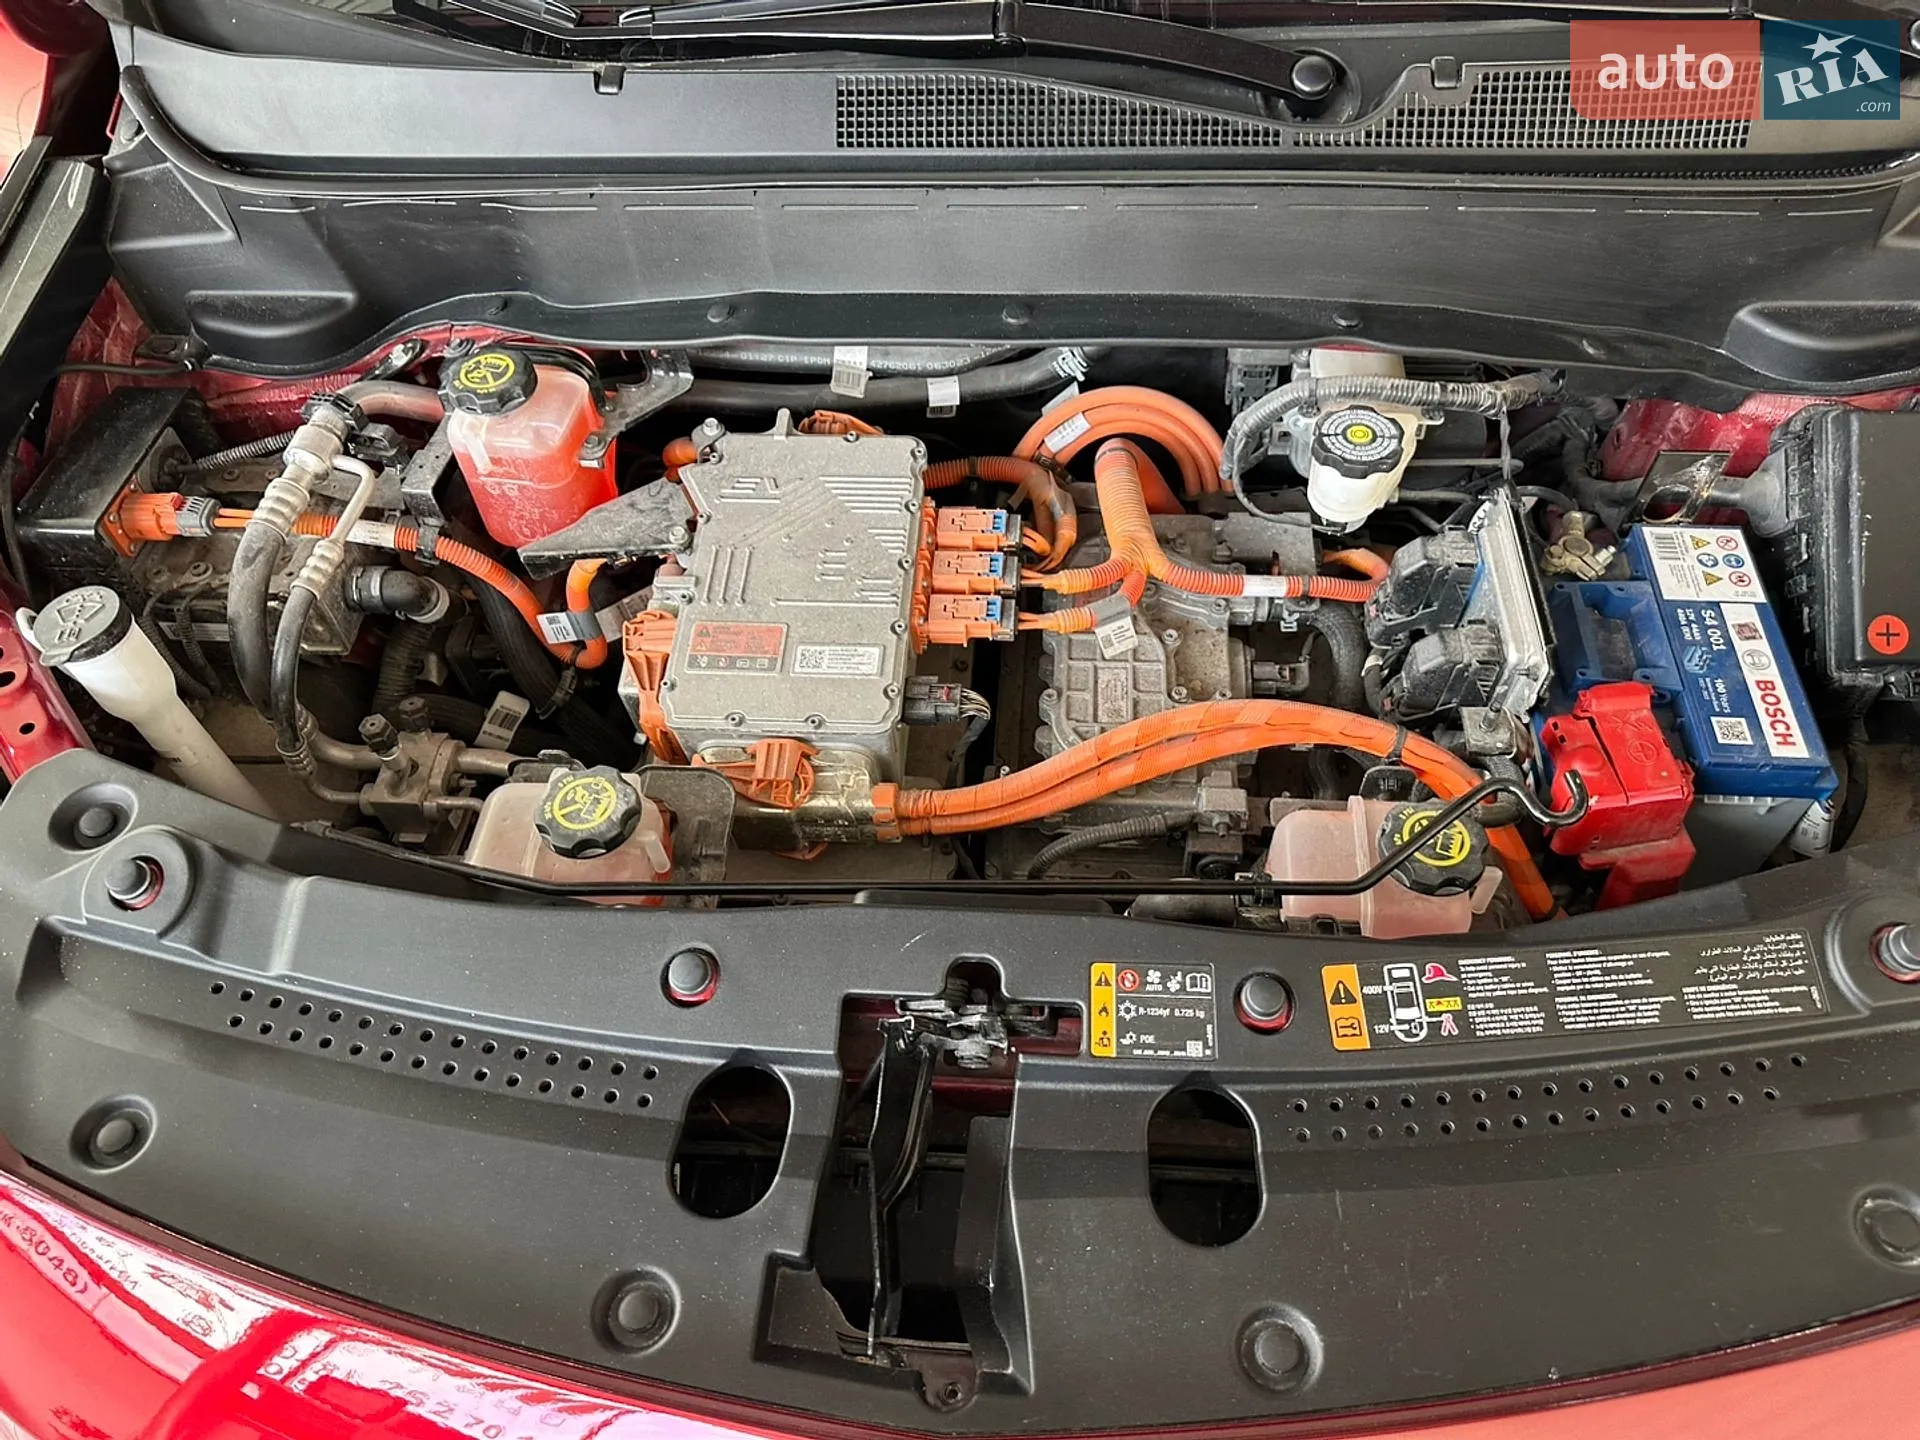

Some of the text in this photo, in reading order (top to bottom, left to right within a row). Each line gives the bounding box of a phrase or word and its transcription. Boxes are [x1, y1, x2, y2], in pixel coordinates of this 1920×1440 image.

[1701, 609, 1727, 651] S4 001
[1755, 680, 1797, 746] BOSCH
[1146, 983, 1163, 992] AUTO
[1373, 1024, 1390, 1034] 12V
